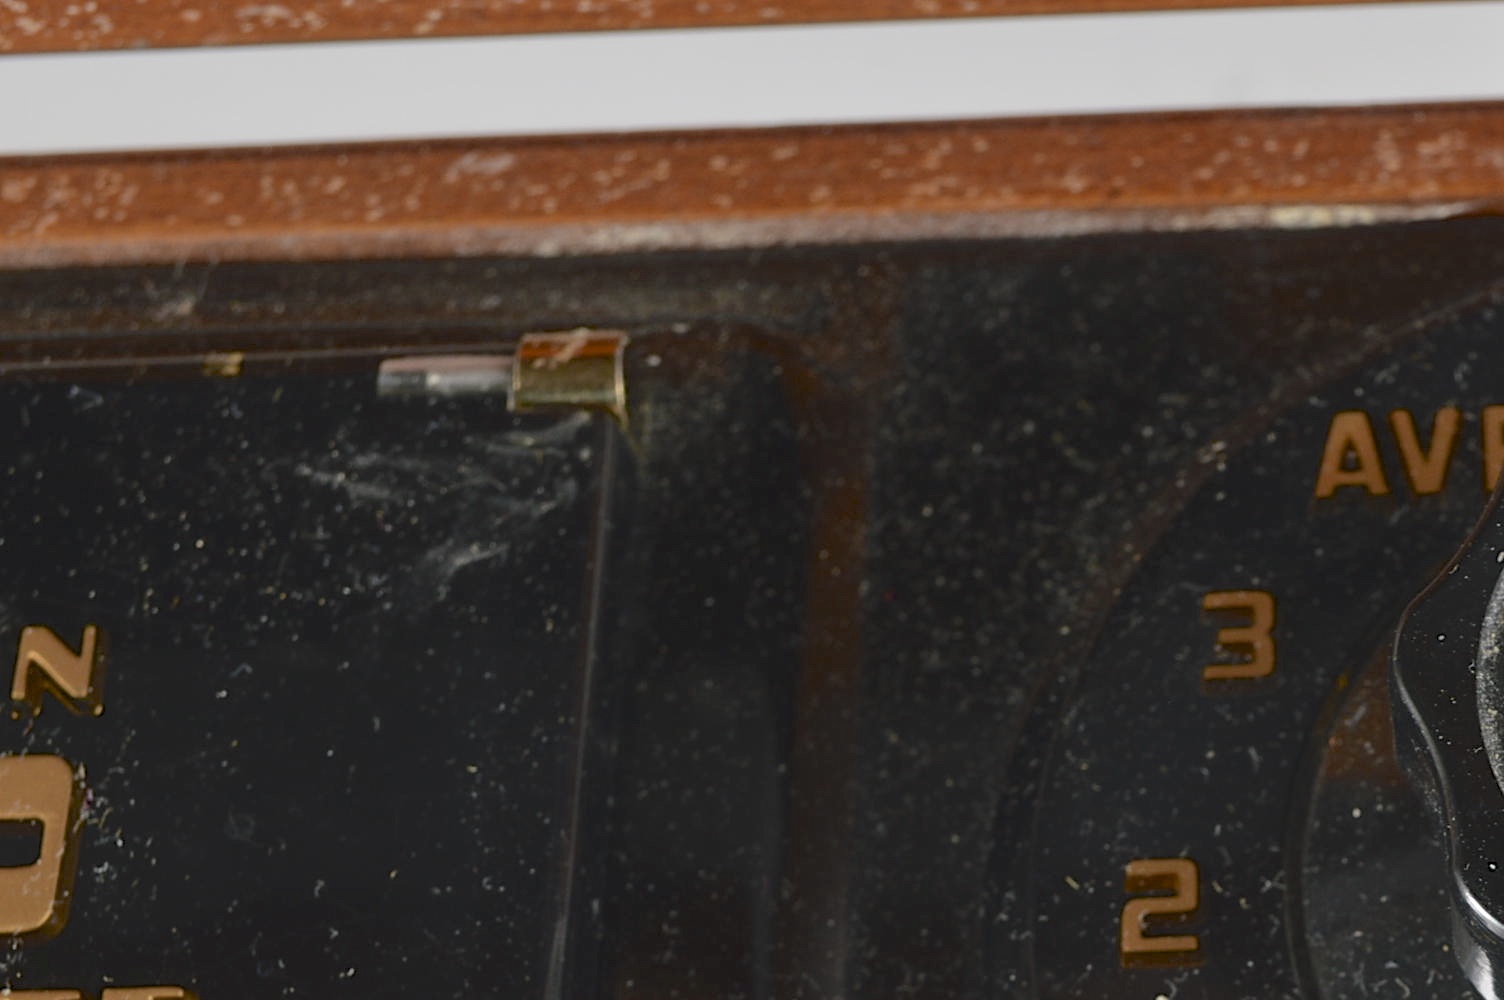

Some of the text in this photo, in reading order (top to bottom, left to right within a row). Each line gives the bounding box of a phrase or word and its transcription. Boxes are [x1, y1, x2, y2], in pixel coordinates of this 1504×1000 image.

[10, 625, 104, 716] N
[1202, 591, 1277, 682] 3
[1120, 860, 1204, 962] 2
